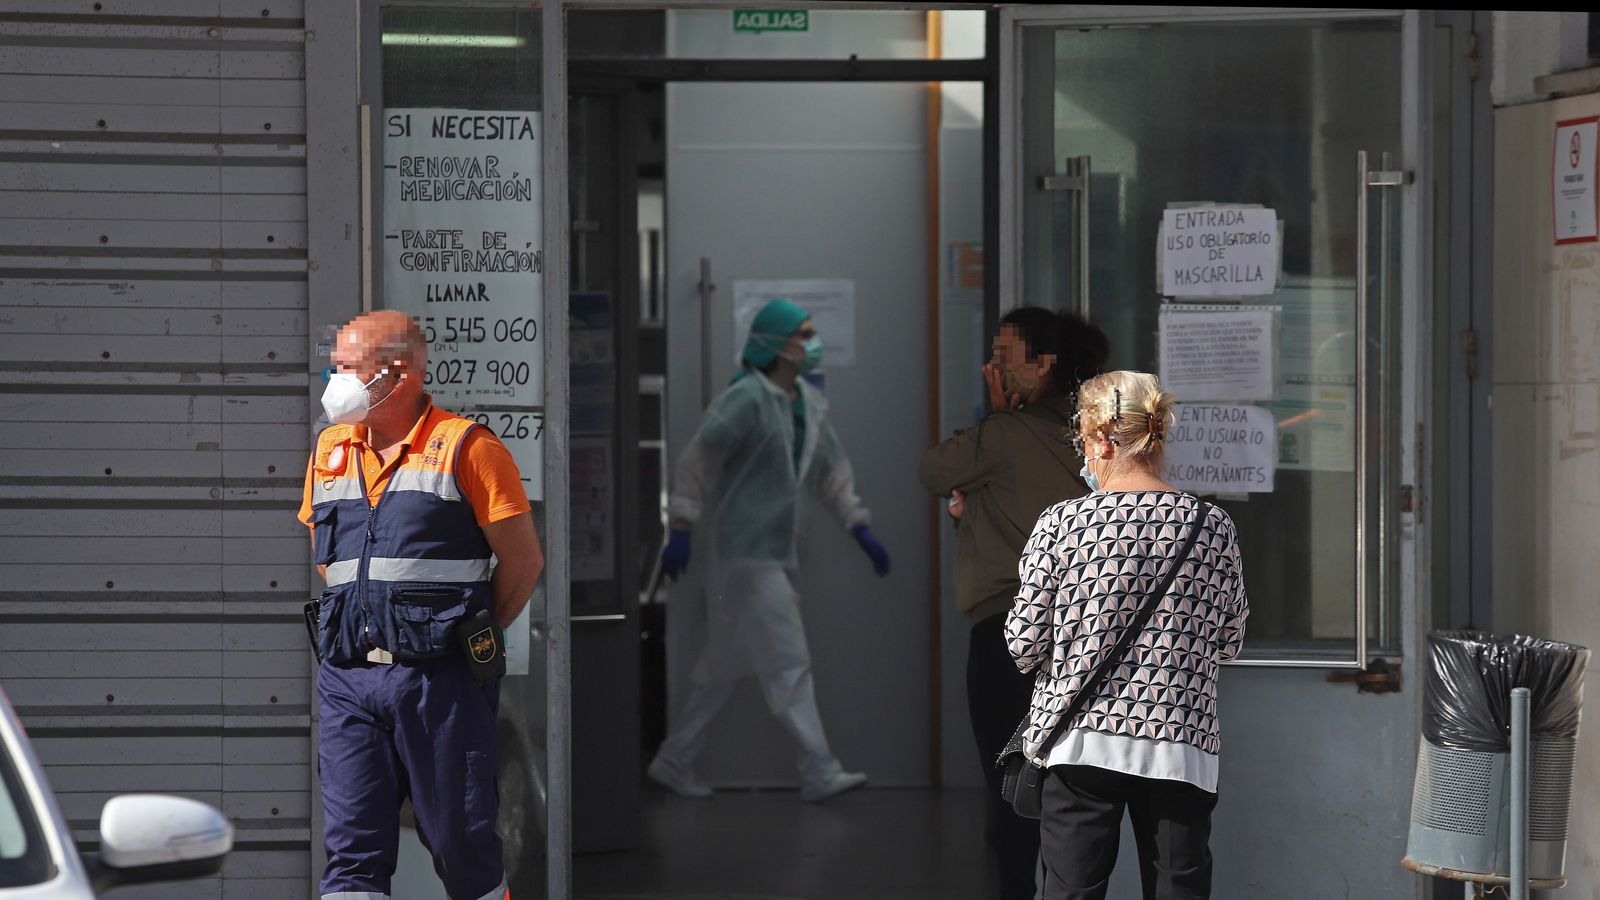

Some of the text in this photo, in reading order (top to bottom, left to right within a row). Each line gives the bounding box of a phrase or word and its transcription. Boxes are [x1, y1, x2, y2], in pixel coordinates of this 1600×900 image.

[388, 114, 534, 140] SI NECESITA
[400, 171, 531, 201] MEDICACIÓN
[1175, 210, 1245, 230] ENTRADA
[482, 231, 507, 250] DE
[1167, 235, 1194, 251] USO
[400, 241, 541, 273] CONFIRMACIÓN
[1208, 247, 1226, 261] DE
[1174, 264, 1263, 286] MASCARILLA
[426, 282, 490, 302] LLAMAR
[445, 317, 486, 343] 545
[493, 317, 537, 343] 060
[486, 360, 530, 386] 900
[1181, 406, 1248, 423] ENTRADA
[499, 413, 543, 440] 267
[1168, 426, 1264, 445] SOLO USUARIO
[1203, 446, 1223, 460] NO
[1169, 462, 1266, 483] ACOMPAÑANTES
